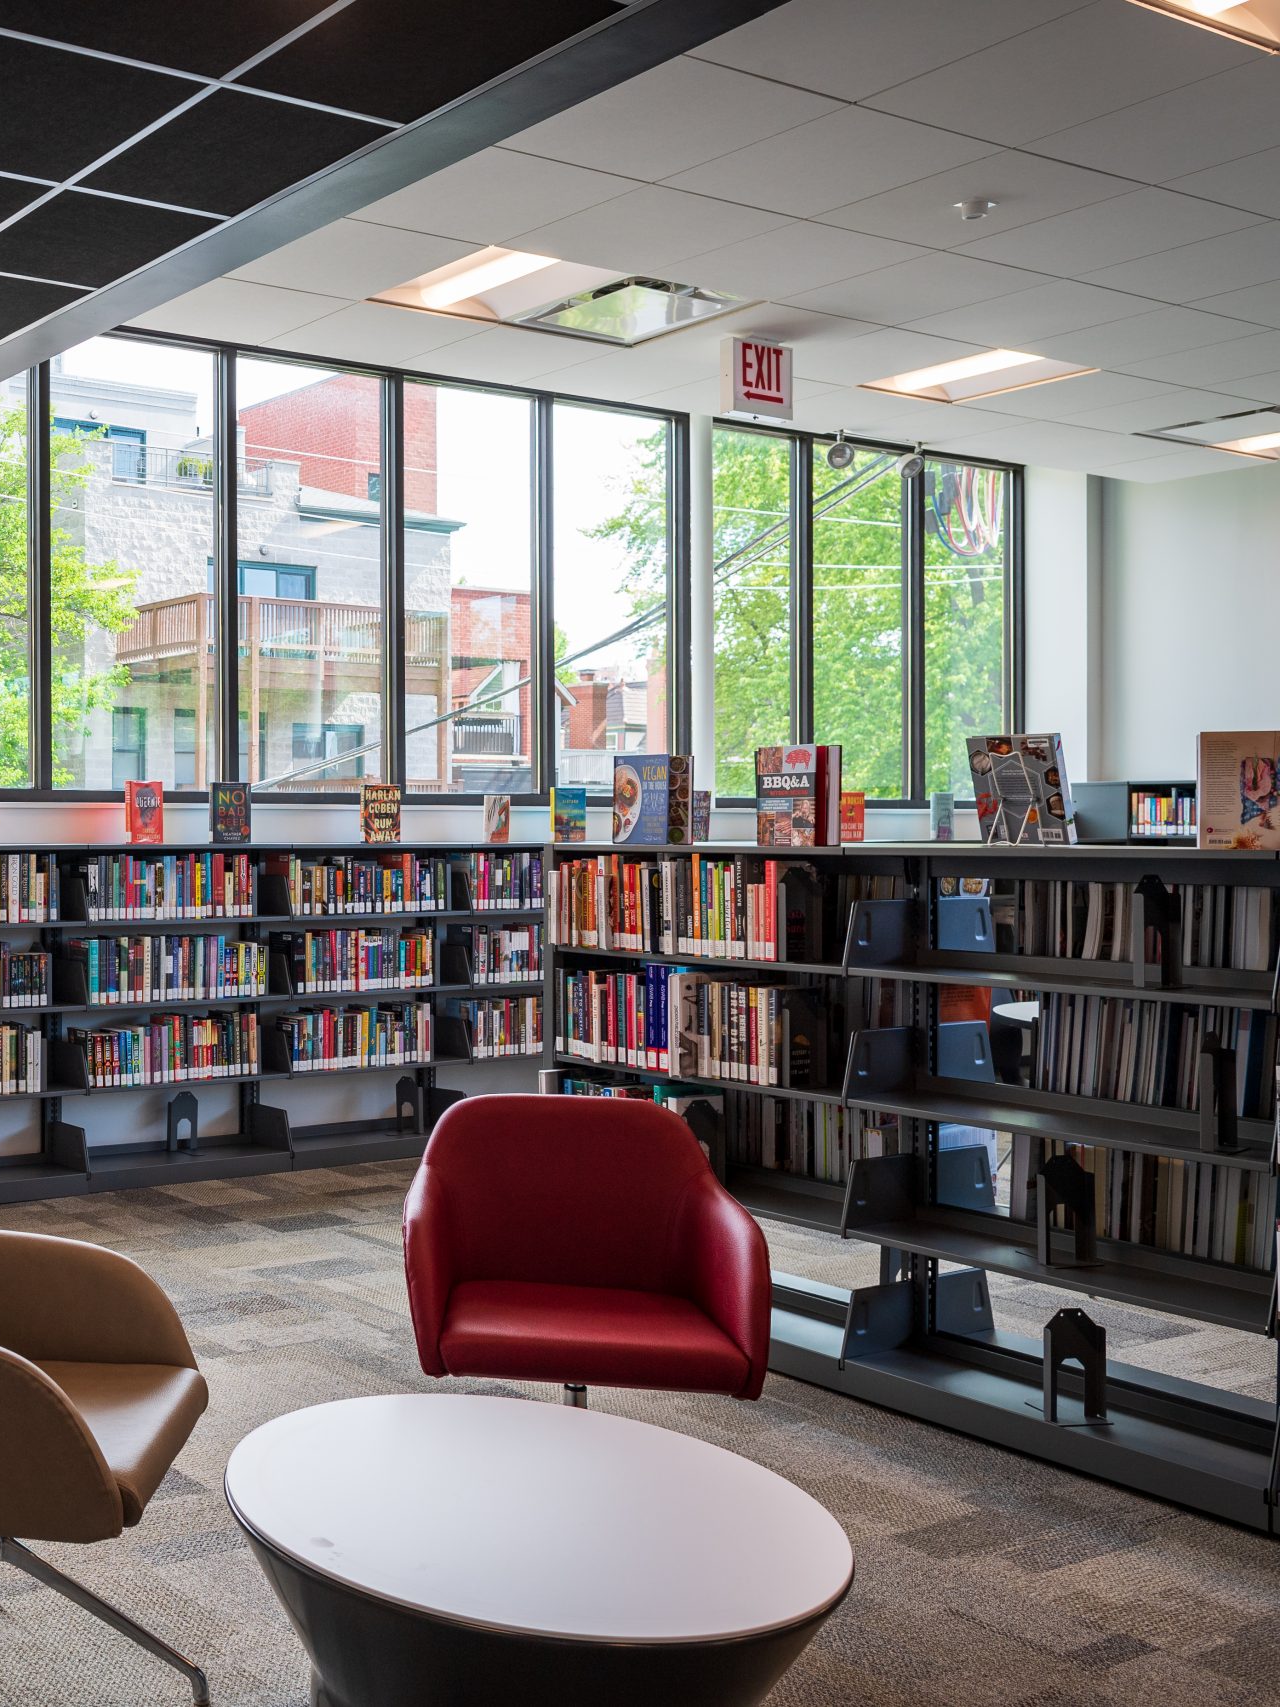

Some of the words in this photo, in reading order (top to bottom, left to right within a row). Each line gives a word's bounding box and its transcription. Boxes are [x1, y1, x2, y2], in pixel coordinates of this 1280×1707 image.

[742, 343, 783, 392] EXIT
[642, 766, 666, 780] VEGAN
[763, 776, 809, 790] BBQ&A
[218, 790, 245, 805] NO
[366, 790, 400, 800] HARLAN
[218, 806, 245, 816] BAD
[369, 802, 398, 814] COBEN
[374, 818, 392, 828] RUN
[370, 830, 396, 842] AWAY
[10, 857, 19, 874] IRON
[10, 876, 19, 896] GOLD
